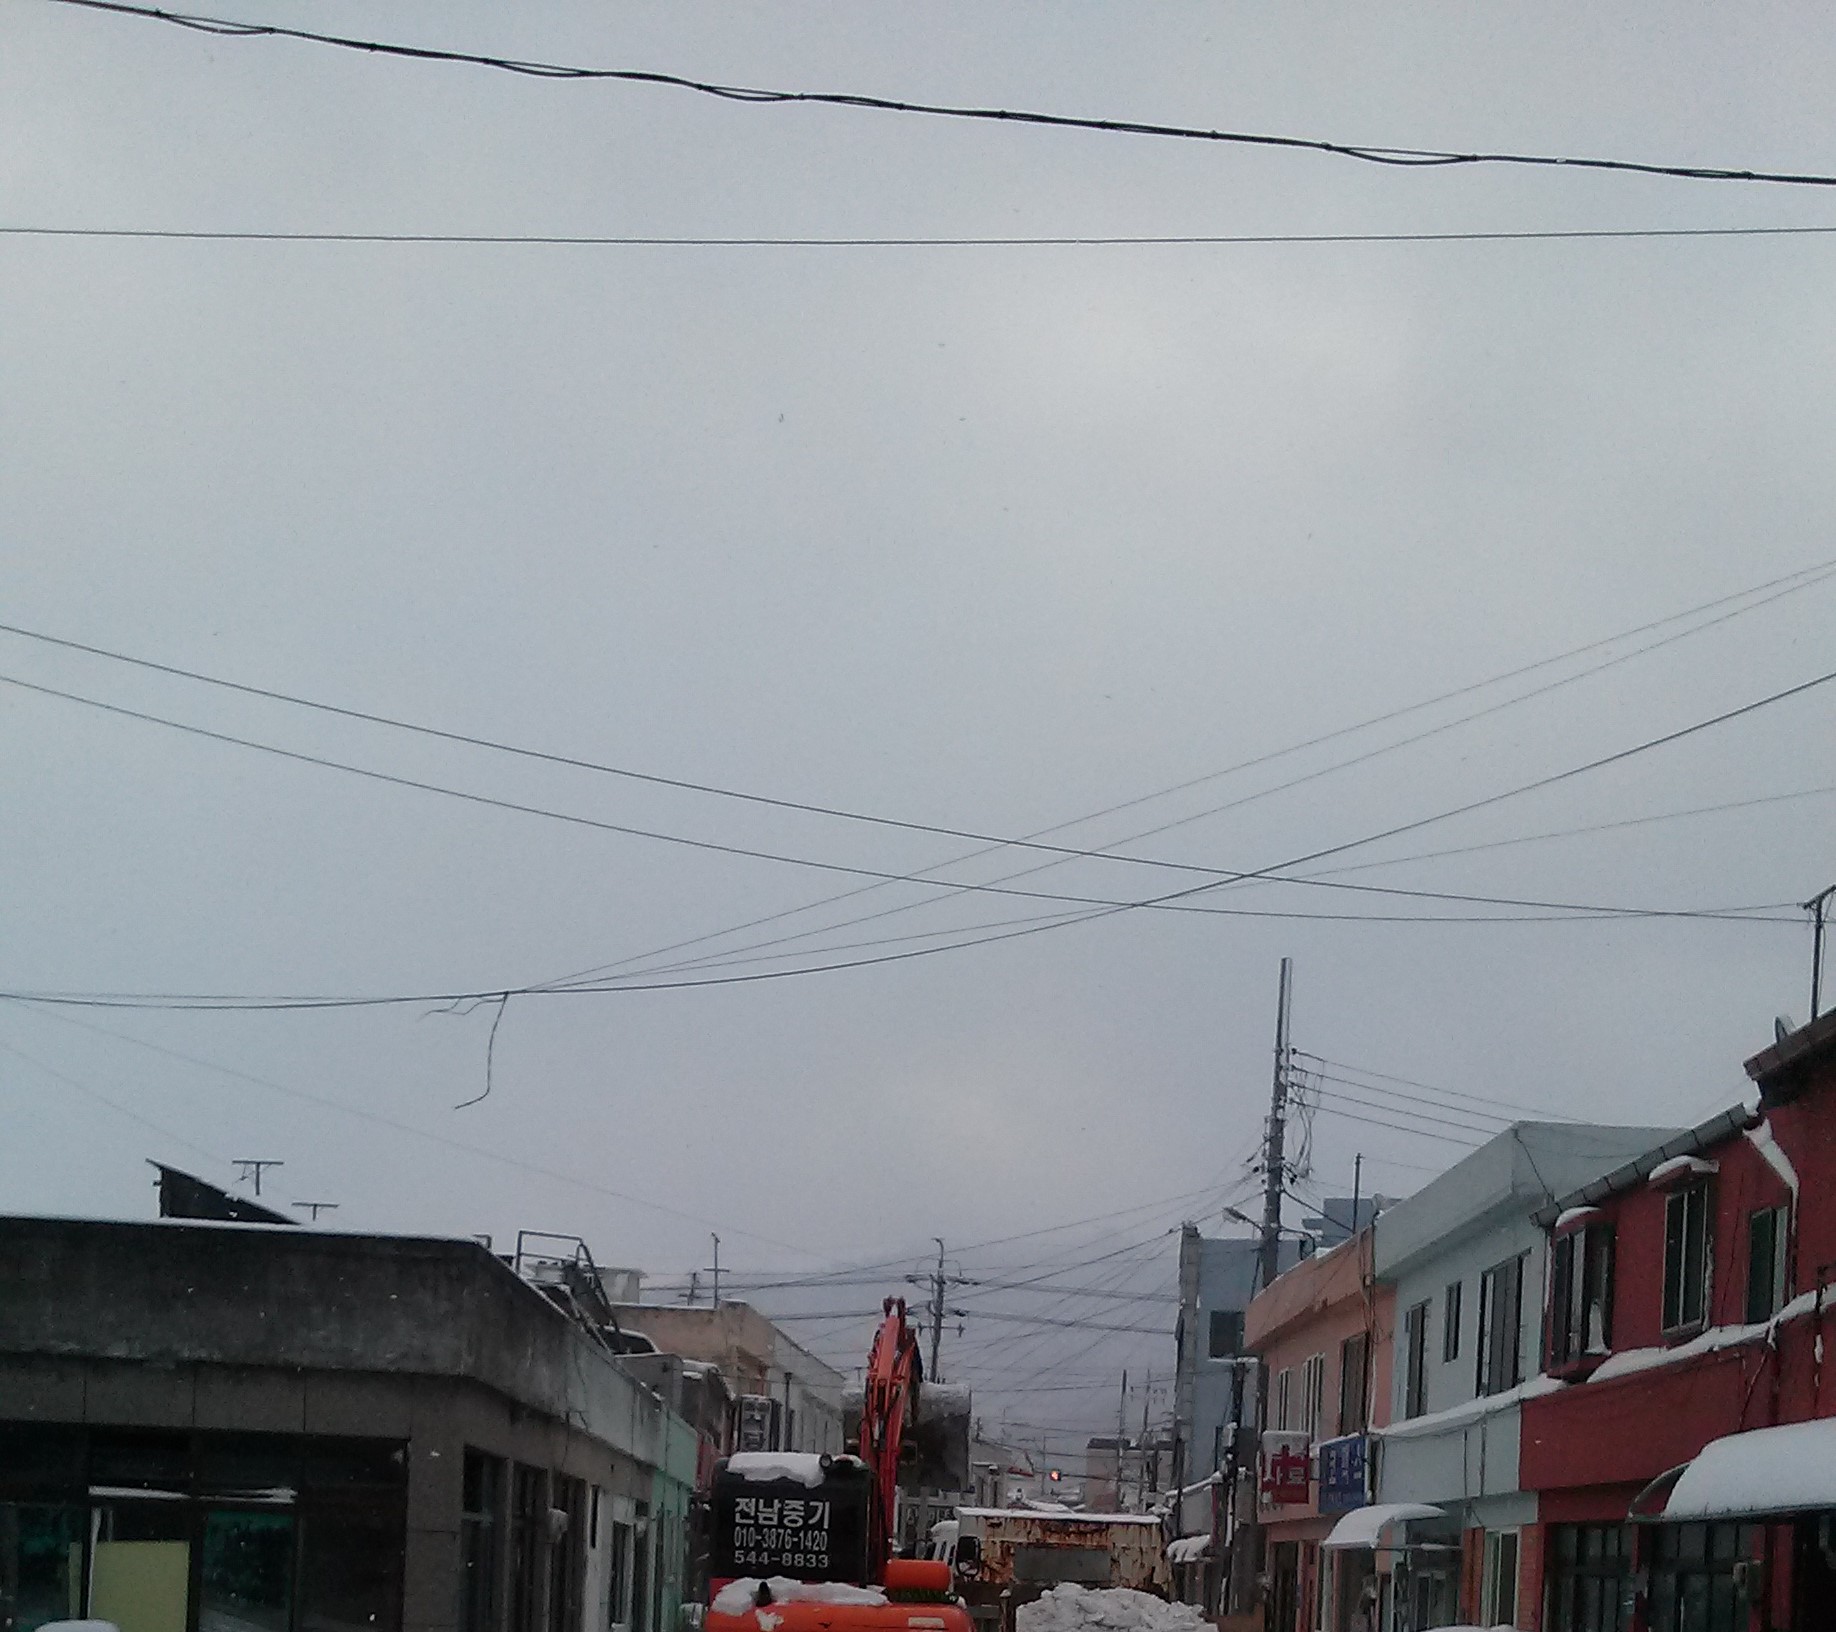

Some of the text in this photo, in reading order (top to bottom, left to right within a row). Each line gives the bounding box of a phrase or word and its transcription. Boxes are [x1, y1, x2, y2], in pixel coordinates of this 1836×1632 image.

[734, 1498, 830, 1529] 전남중기
[734, 1527, 828, 1551] 010-3876-1420
[734, 1551, 829, 1568] 544-8833
